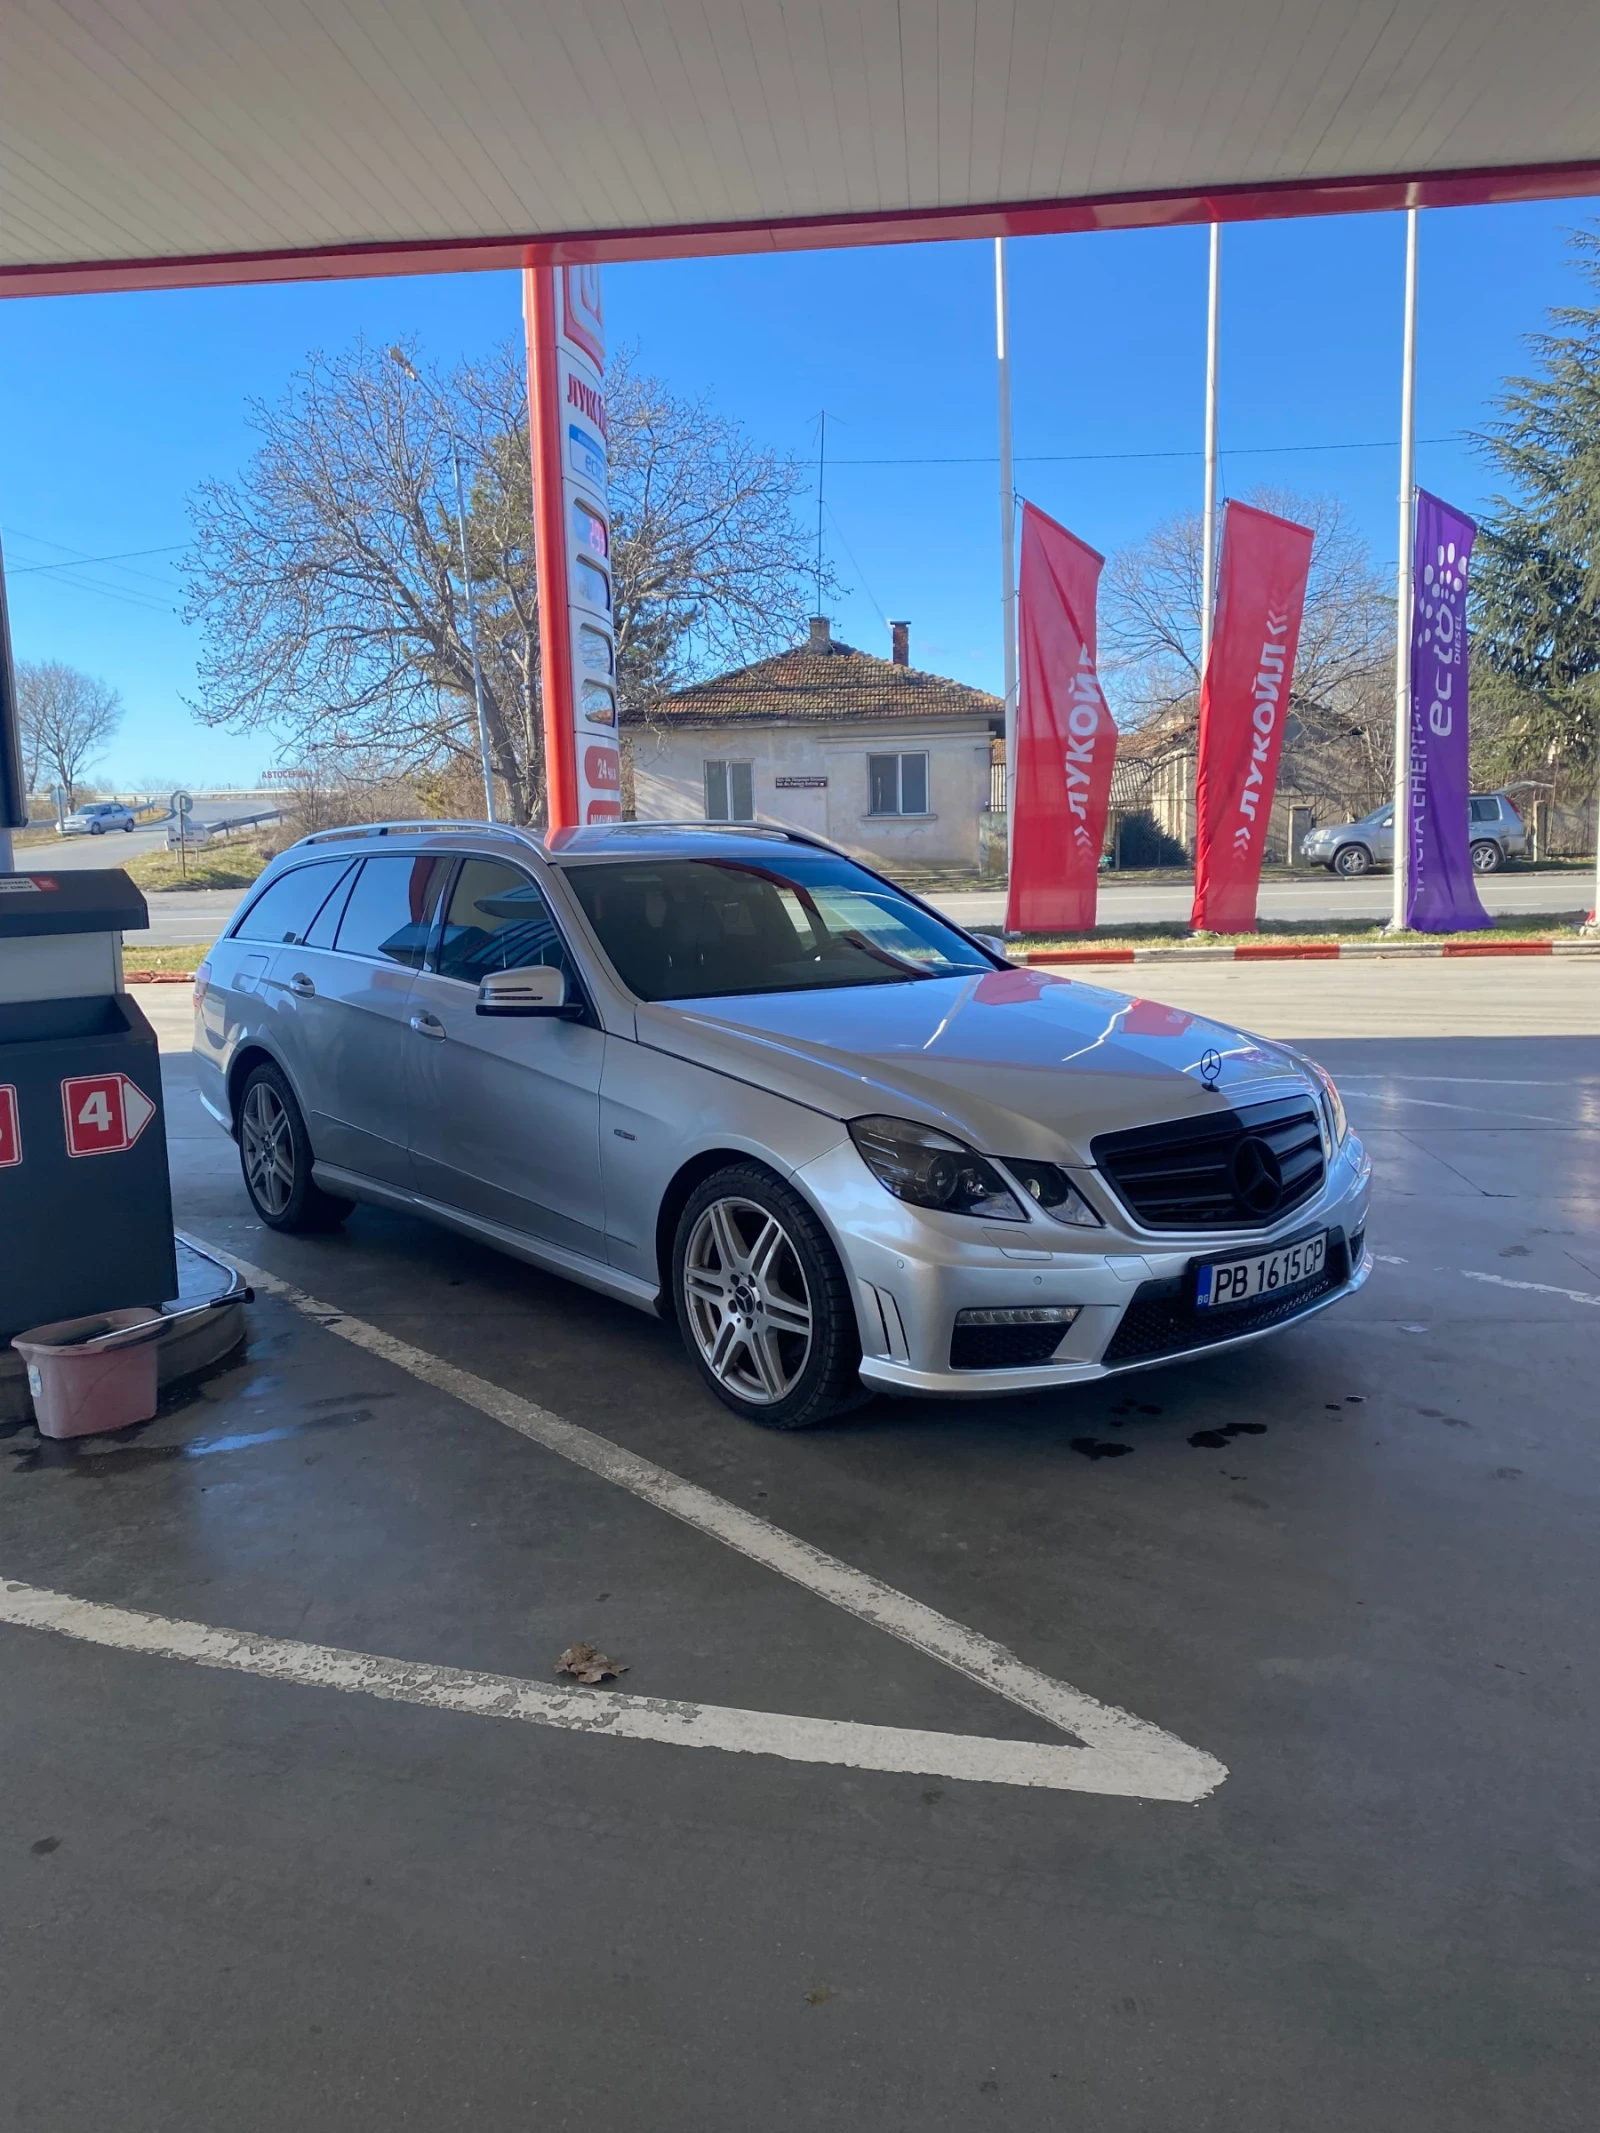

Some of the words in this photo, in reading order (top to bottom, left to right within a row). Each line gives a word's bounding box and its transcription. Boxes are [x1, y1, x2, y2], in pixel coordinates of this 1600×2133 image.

[1453, 613, 1462, 665] DIESEL
[1240, 642, 1286, 821] ЛУКОЙЛ
[598, 758, 607, 779] 24
[78, 1091, 113, 1131] 4
[1210, 1265, 1248, 1303] PB
[1257, 1249, 1301, 1293] 1615
[1197, 1294, 1209, 1305] BG
